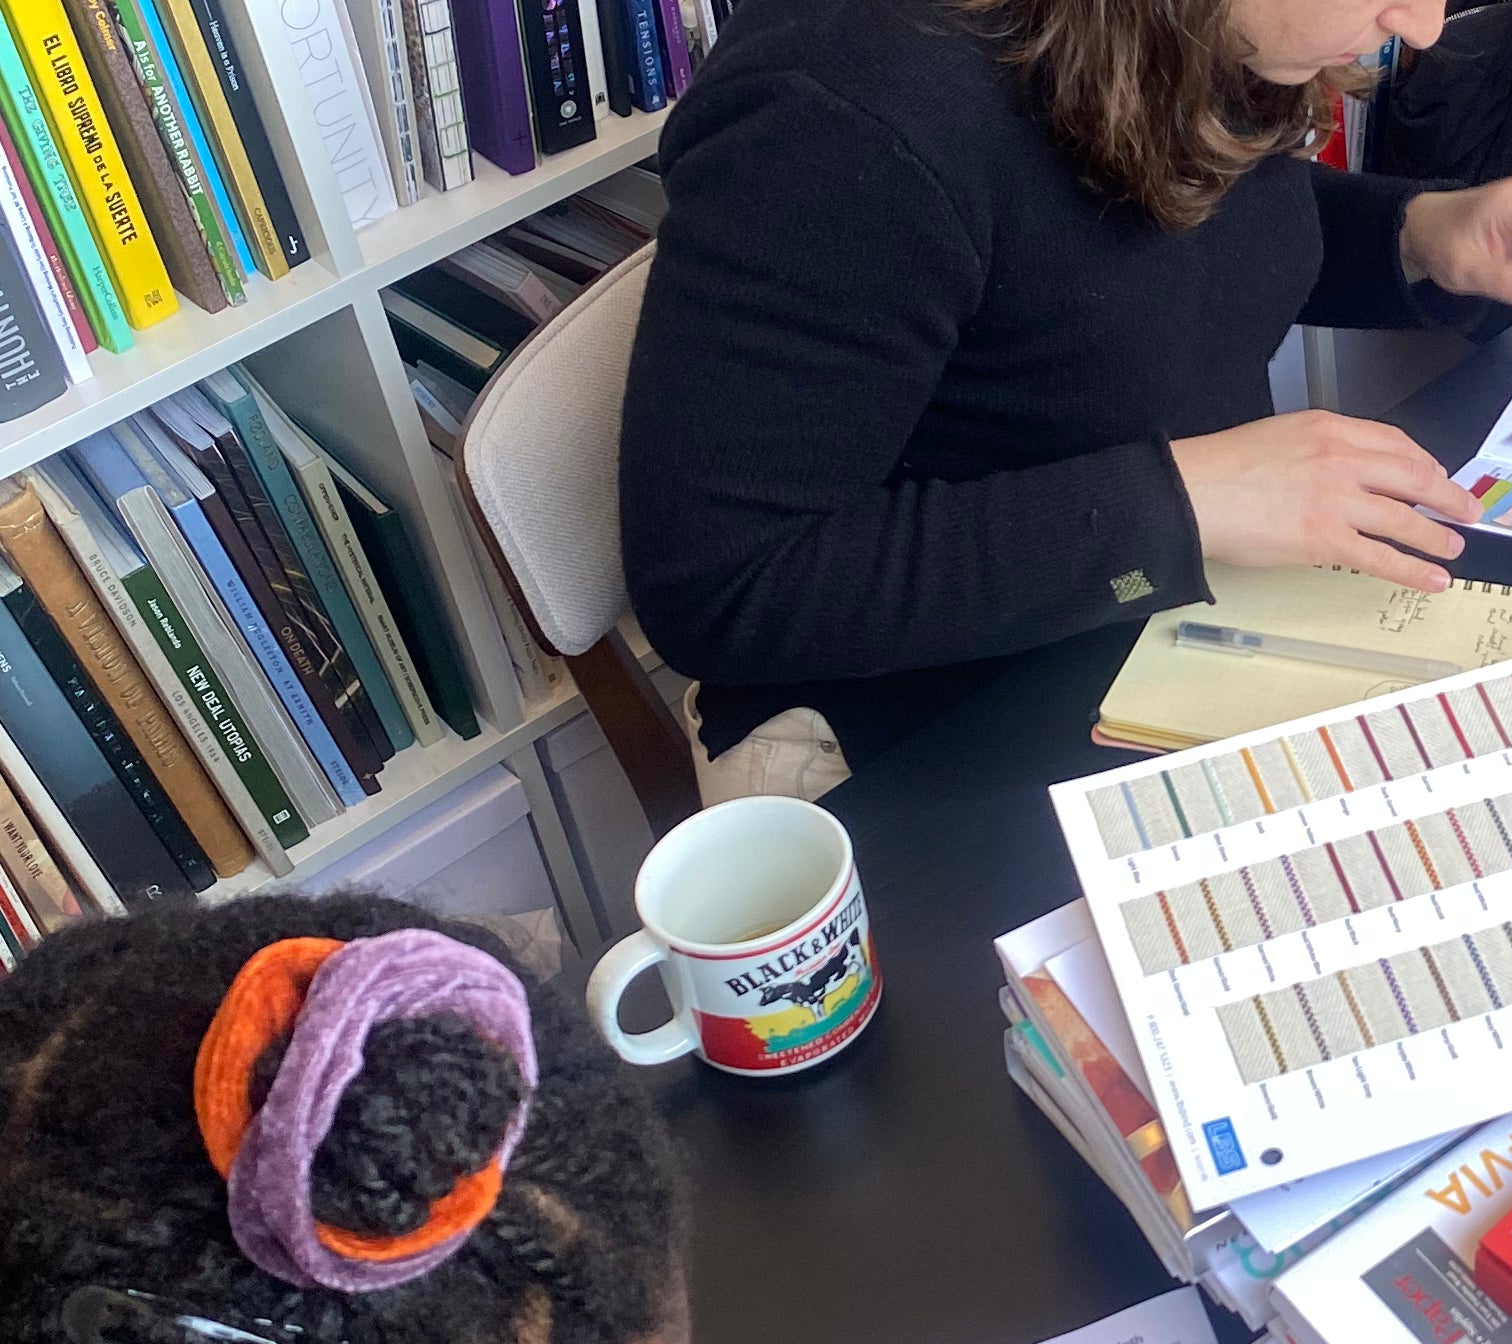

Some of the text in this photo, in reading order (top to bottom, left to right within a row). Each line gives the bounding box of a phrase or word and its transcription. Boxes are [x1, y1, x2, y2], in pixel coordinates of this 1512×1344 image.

[95, 10, 116, 51] Colmer
[209, 20, 224, 52] Heaven
[228, 66, 239, 90] Prison
[638, 9, 657, 87] TENSIONS
[18, 85, 37, 115] THE
[32, 118, 60, 170] GIVING
[50, 173, 77, 213] TREE
[43, 34, 139, 246] EL LIBRO SUPREMO DE LA SUERTE
[134, 40, 146, 55] A
[152, 86, 183, 151] ANOTHER
[176, 146, 204, 196] RABBIT
[88, 553, 209, 746] BRUCE DAVIDSON LOS ANGELES
[147, 598, 164, 625] Jason
[186, 665, 210, 693] NEW
[201, 685, 230, 722] DEAL
[218, 717, 252, 764] UTOPIAS
[280, 625, 315, 676] ON DEATH
[4, 823, 44, 881] WANT YOUR LOVE
[725, 943, 810, 997] BLACK
[811, 938, 821, 955] &
